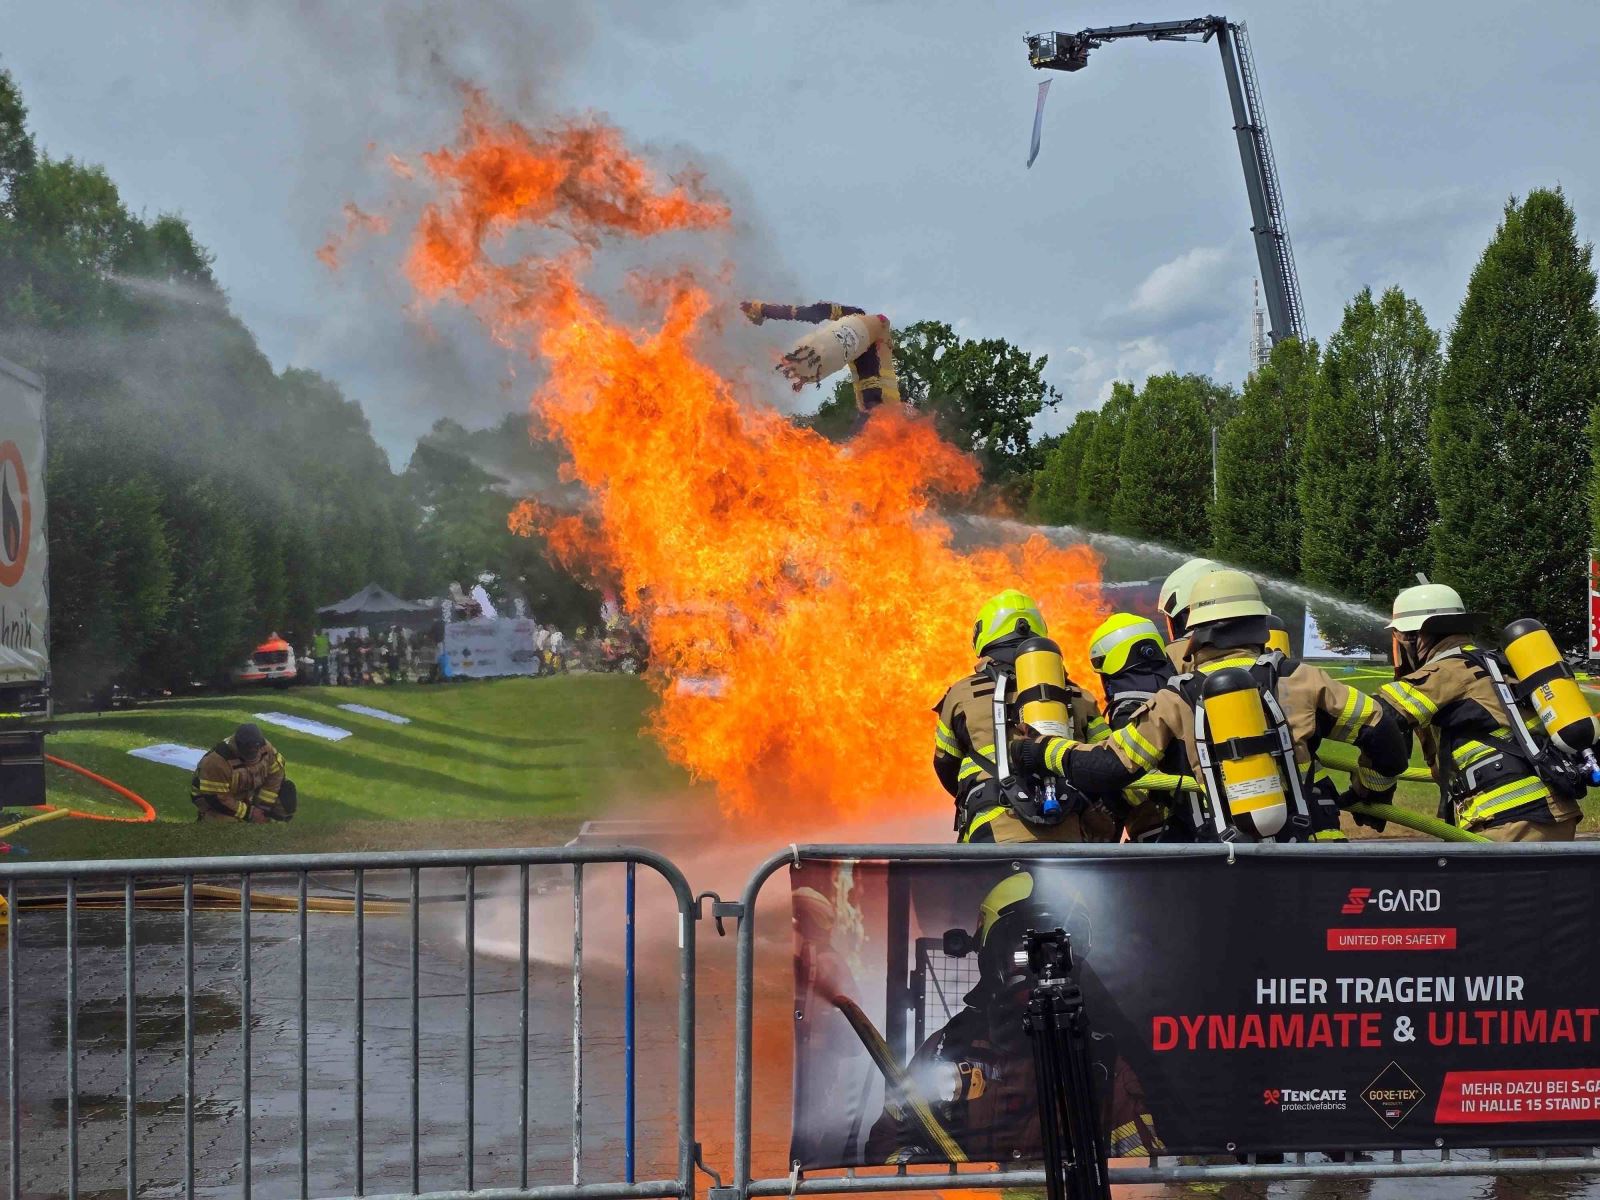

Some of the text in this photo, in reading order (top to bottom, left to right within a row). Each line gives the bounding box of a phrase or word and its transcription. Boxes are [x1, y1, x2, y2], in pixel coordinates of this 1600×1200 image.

[1341, 888, 1441, 914] S-GARD
[1339, 934, 1446, 946] UNITED FOR SAFETY
[1256, 975, 1524, 1004] HIER TRAGEN WIR
[1152, 1013, 1382, 1051] DYNAMATE
[1393, 1015, 1416, 1042] &
[1369, 1090, 1416, 1100] GORE-TEX
[1461, 1083, 1503, 1096] MEHR
[1506, 1081, 1543, 1095] DAZU
[1546, 1081, 1568, 1094] BEI
[1281, 1101, 1347, 1113] protectivefabrics
[1461, 1099, 1476, 1112] IN
[1479, 1099, 1523, 1112] HALLE
[1526, 1099, 1543, 1111] 15
[1545, 1097, 1591, 1111] STAND
